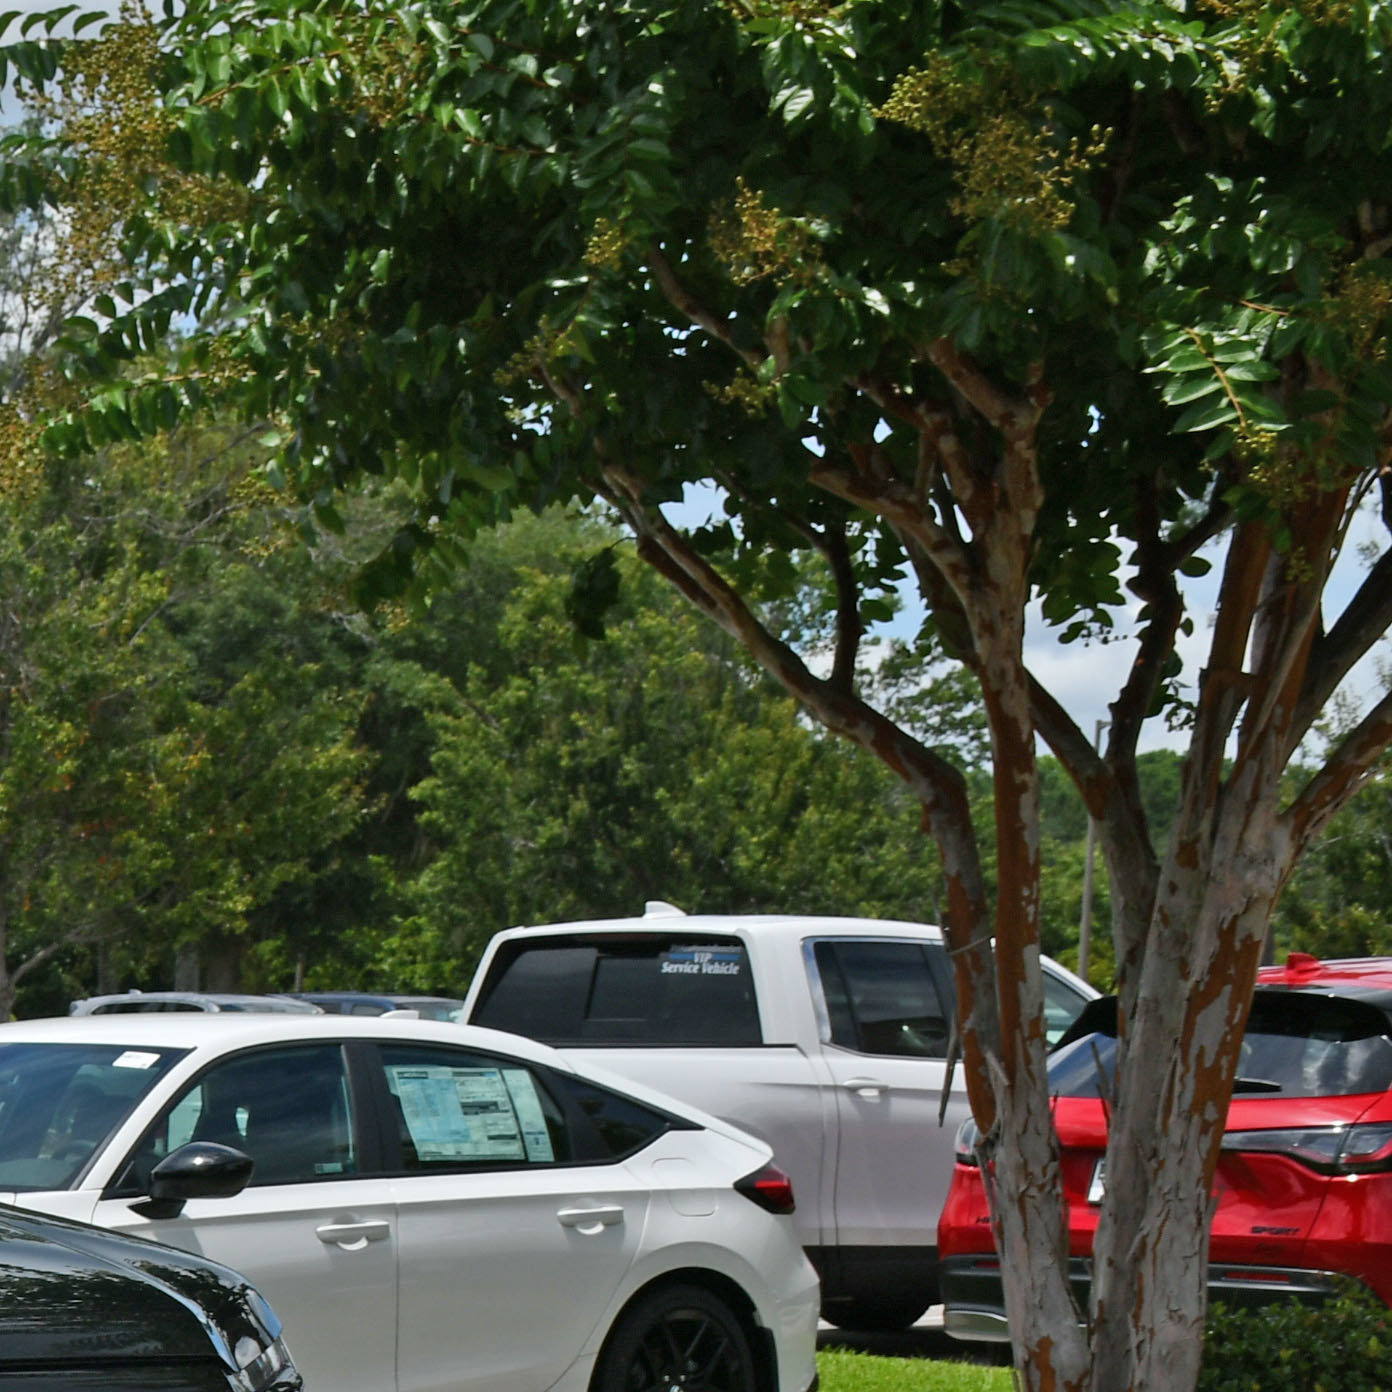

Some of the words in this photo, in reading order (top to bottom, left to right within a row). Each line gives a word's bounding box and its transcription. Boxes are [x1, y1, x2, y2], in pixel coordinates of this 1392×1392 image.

[693, 952, 713, 963] VIP
[661, 962, 699, 974] Service
[702, 962, 740, 975] Vehicle
